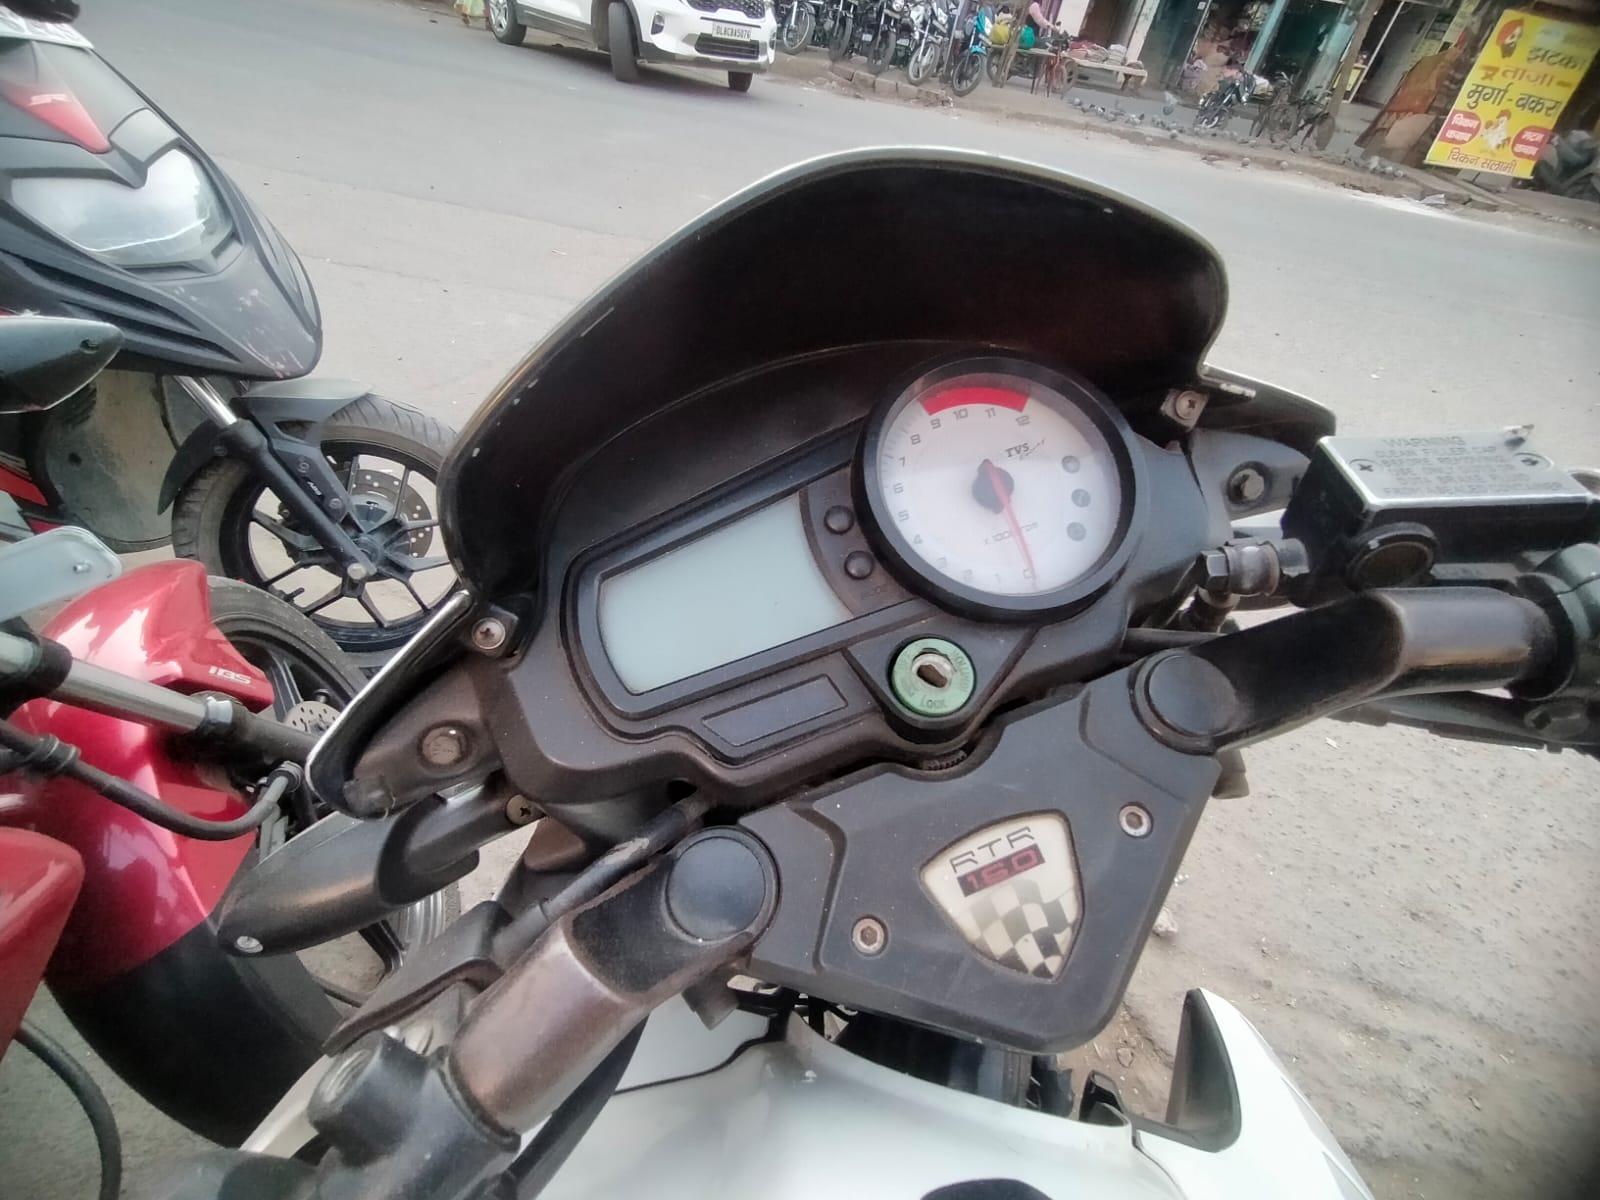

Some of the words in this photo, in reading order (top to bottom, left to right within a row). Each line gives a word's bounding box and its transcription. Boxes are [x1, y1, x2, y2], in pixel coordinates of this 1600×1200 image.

[953, 408, 970, 421] 10
[985, 407, 997, 419] 11
[930, 418, 942, 430] 9
[1016, 414, 1031, 427] 12
[910, 433, 922, 445] 8
[1005, 442, 1030, 458] TVS
[899, 456, 907, 467] 7
[893, 483, 904, 495] 6
[898, 510, 910, 522] 5
[912, 533, 923, 545] 4
[949, 825, 1035, 874] RTR
